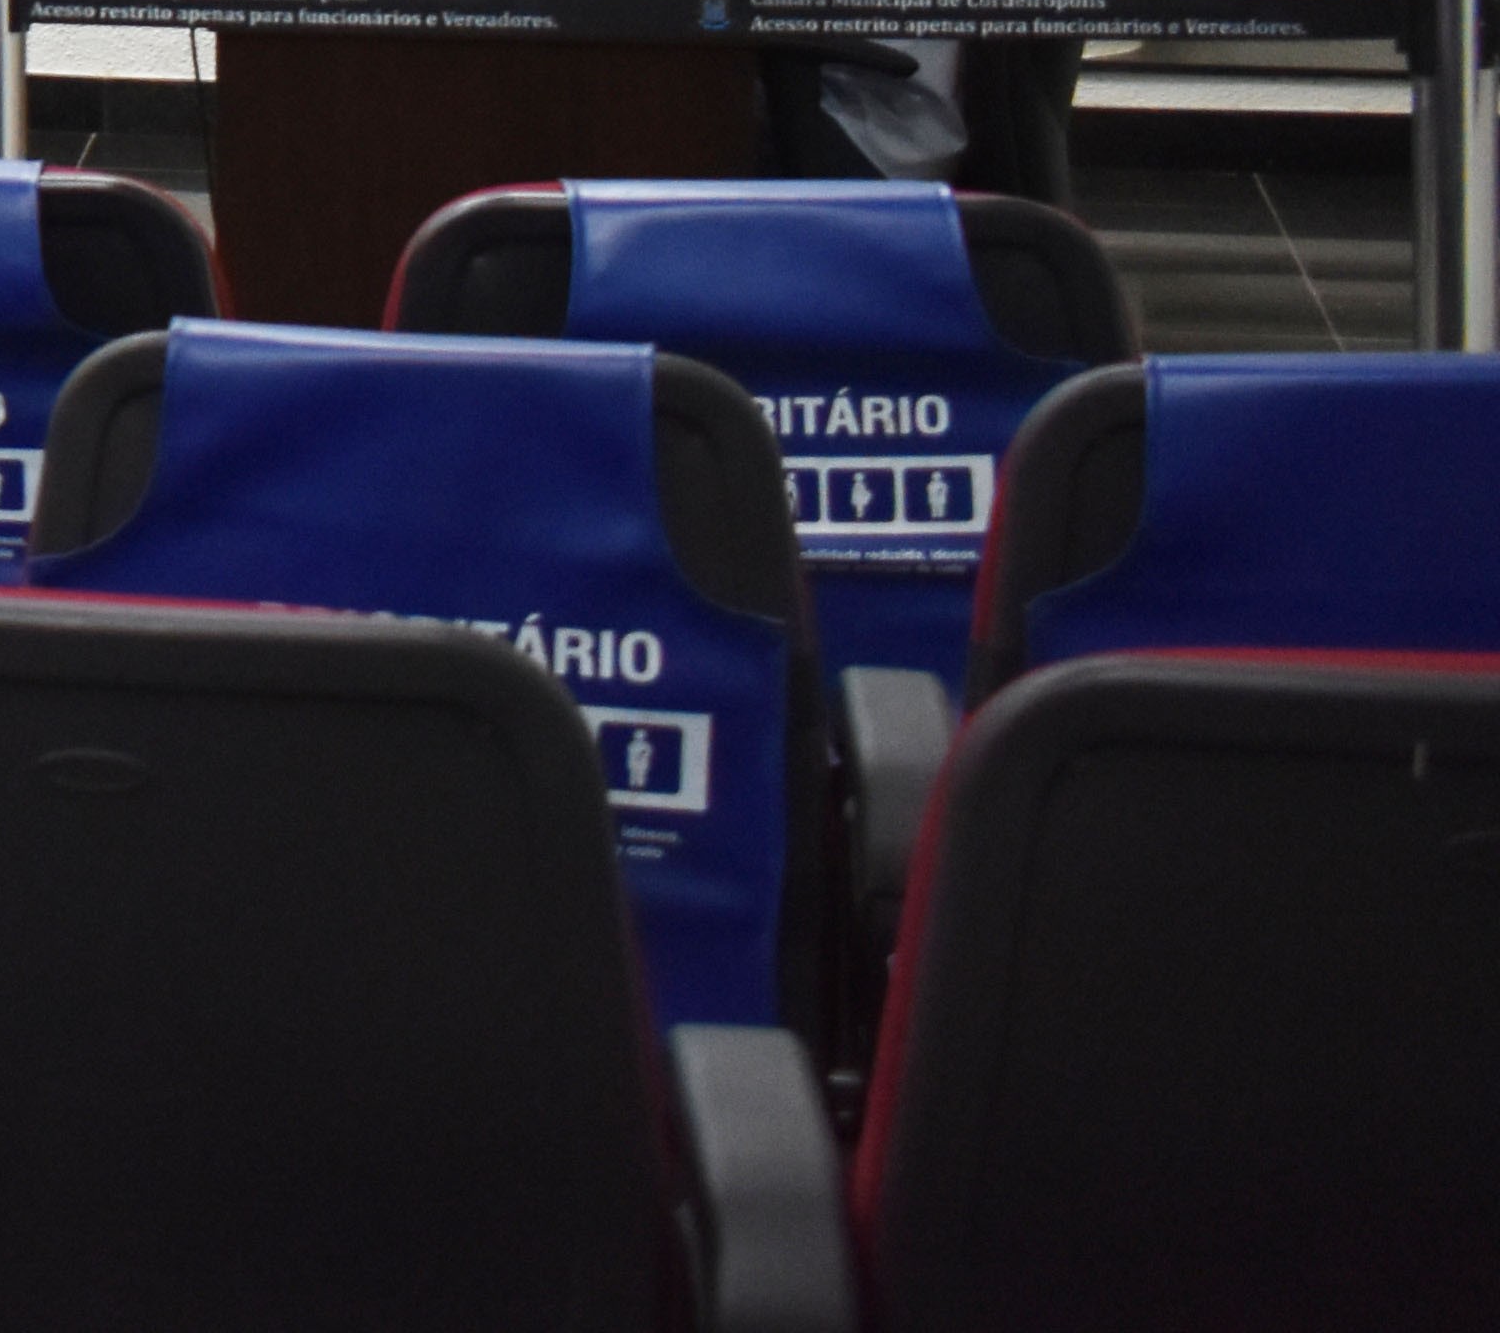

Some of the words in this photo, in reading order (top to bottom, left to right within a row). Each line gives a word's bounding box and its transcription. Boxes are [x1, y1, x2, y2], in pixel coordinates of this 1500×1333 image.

[31, 1, 95, 18] Acesso
[100, 3, 173, 20] restrito
[179, 9, 245, 27] apenas
[250, 11, 293, 27] para
[299, 8, 421, 27] funcionários
[426, 13, 438, 27] e
[442, 10, 558, 29] Vereadores.
[751, 15, 818, 32] Acesso
[823, 17, 898, 33] restrito
[904, 20, 975, 37] apenas
[981, 20, 1027, 37] para
[1033, 17, 1162, 35] funcionários
[1168, 21, 1180, 35] e
[1185, 18, 1306, 35] Vereadores.
